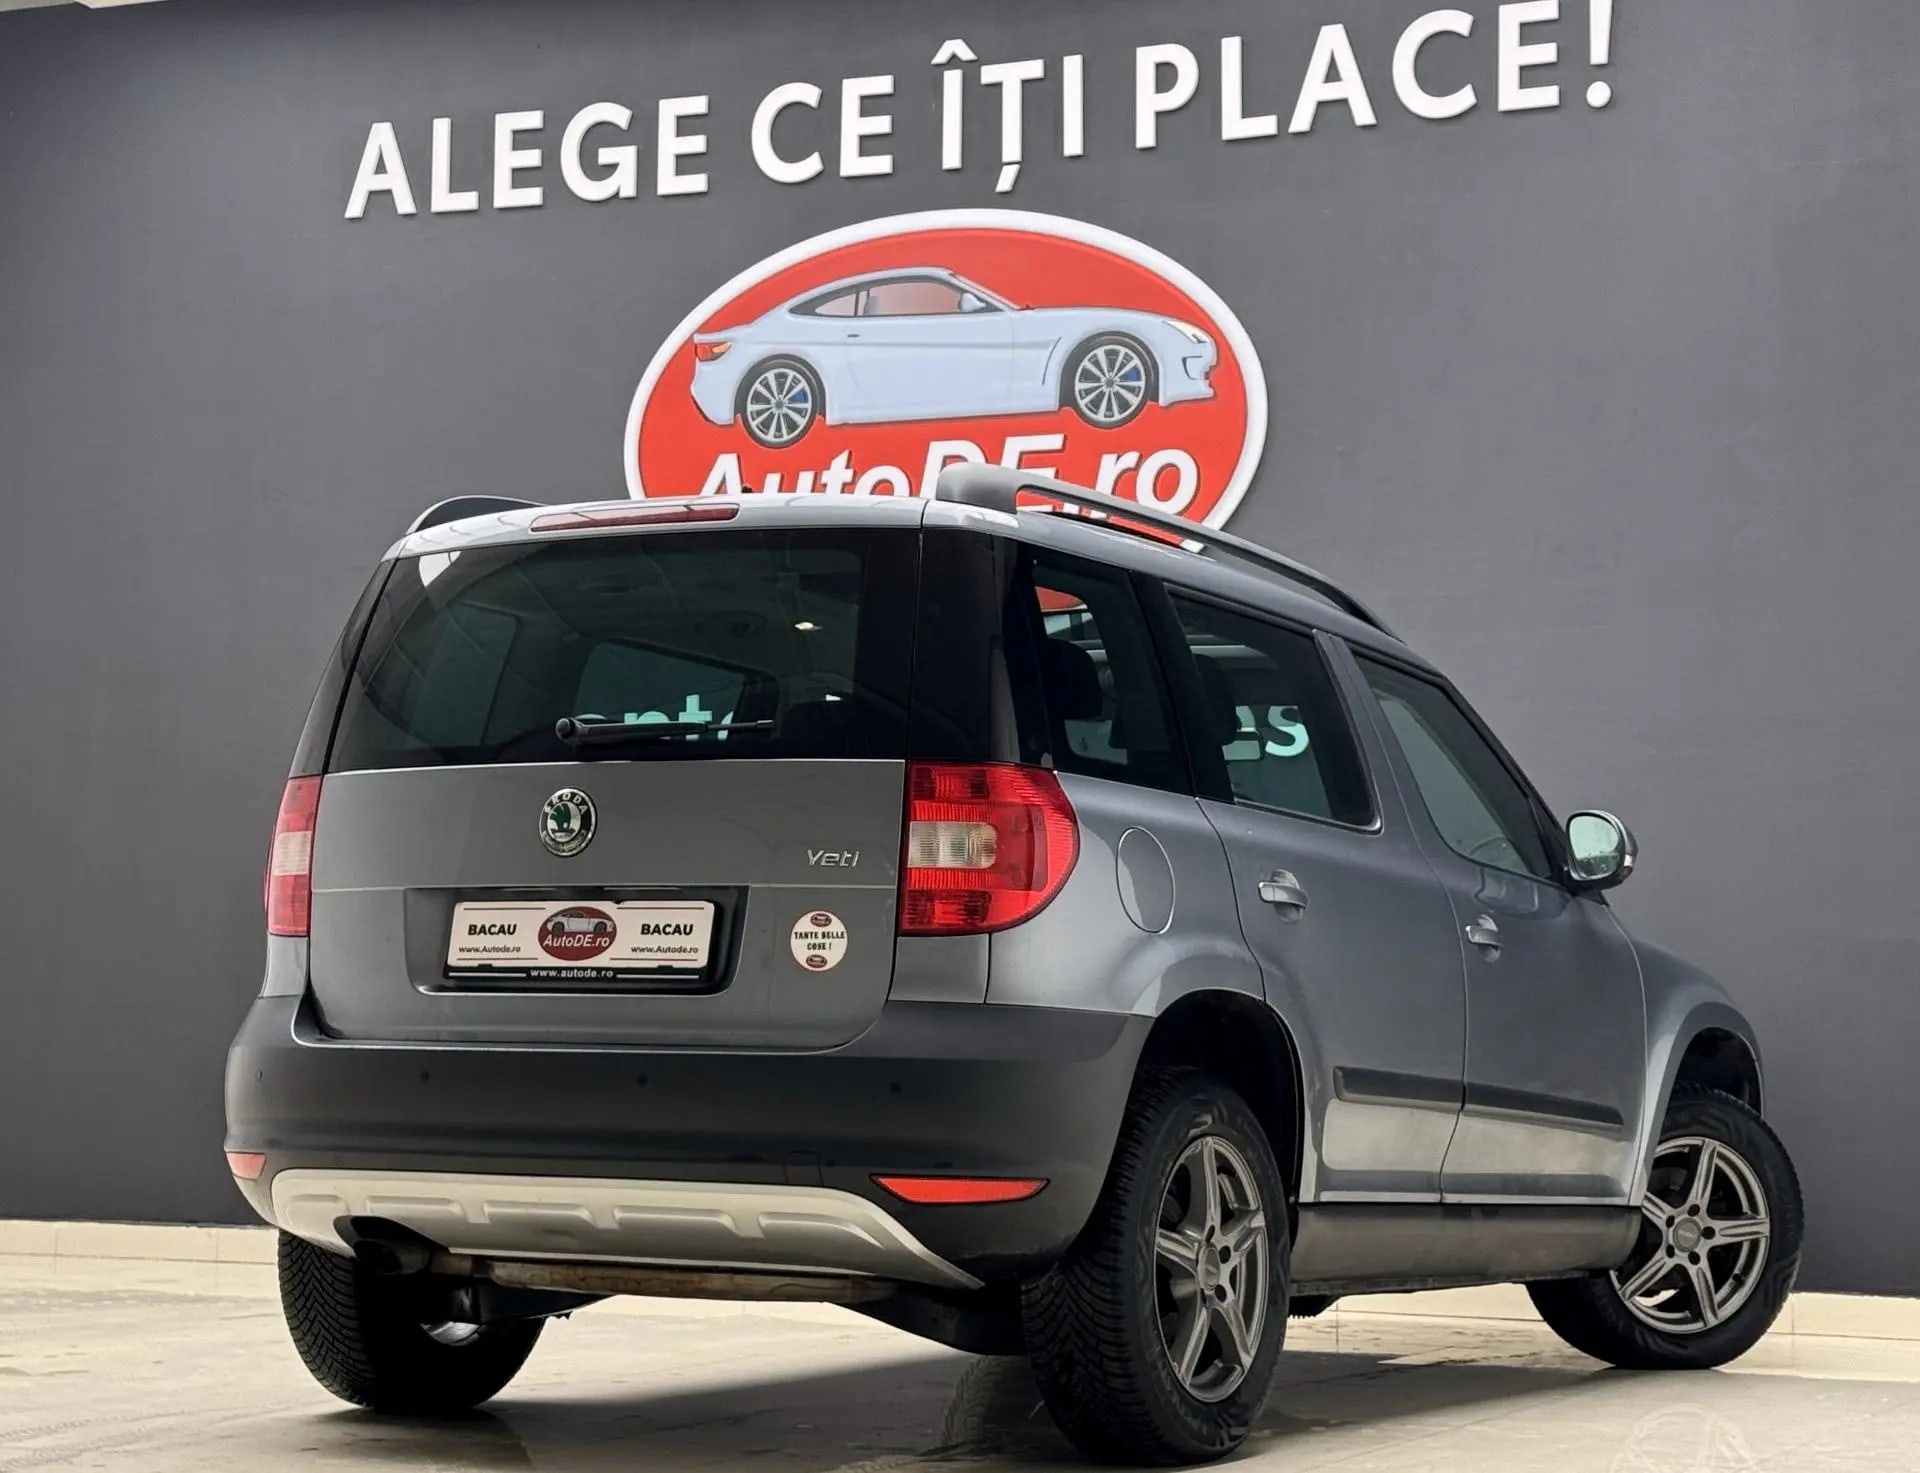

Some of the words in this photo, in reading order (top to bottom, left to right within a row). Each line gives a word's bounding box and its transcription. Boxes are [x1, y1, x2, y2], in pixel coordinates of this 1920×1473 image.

[344, 95, 709, 219] ALEGE
[750, 74, 894, 184] CE
[931, 38, 1084, 193] ÎȚI
[1135, 0, 1613, 149] PLACE!
[807, 849, 860, 867] Yeti
[467, 923, 517, 936] BACAU
[640, 923, 694, 936] BACAU
[542, 934, 610, 948] AutoDE.ro
[794, 931, 818, 940] TANTE
[821, 931, 845, 940] BELLE
[458, 944, 521, 953] www.Autode.ro
[630, 945, 699, 954] www.Autode.ro
[806, 942, 827, 951] COSE
[530, 968, 614, 978] www.autode.ro
